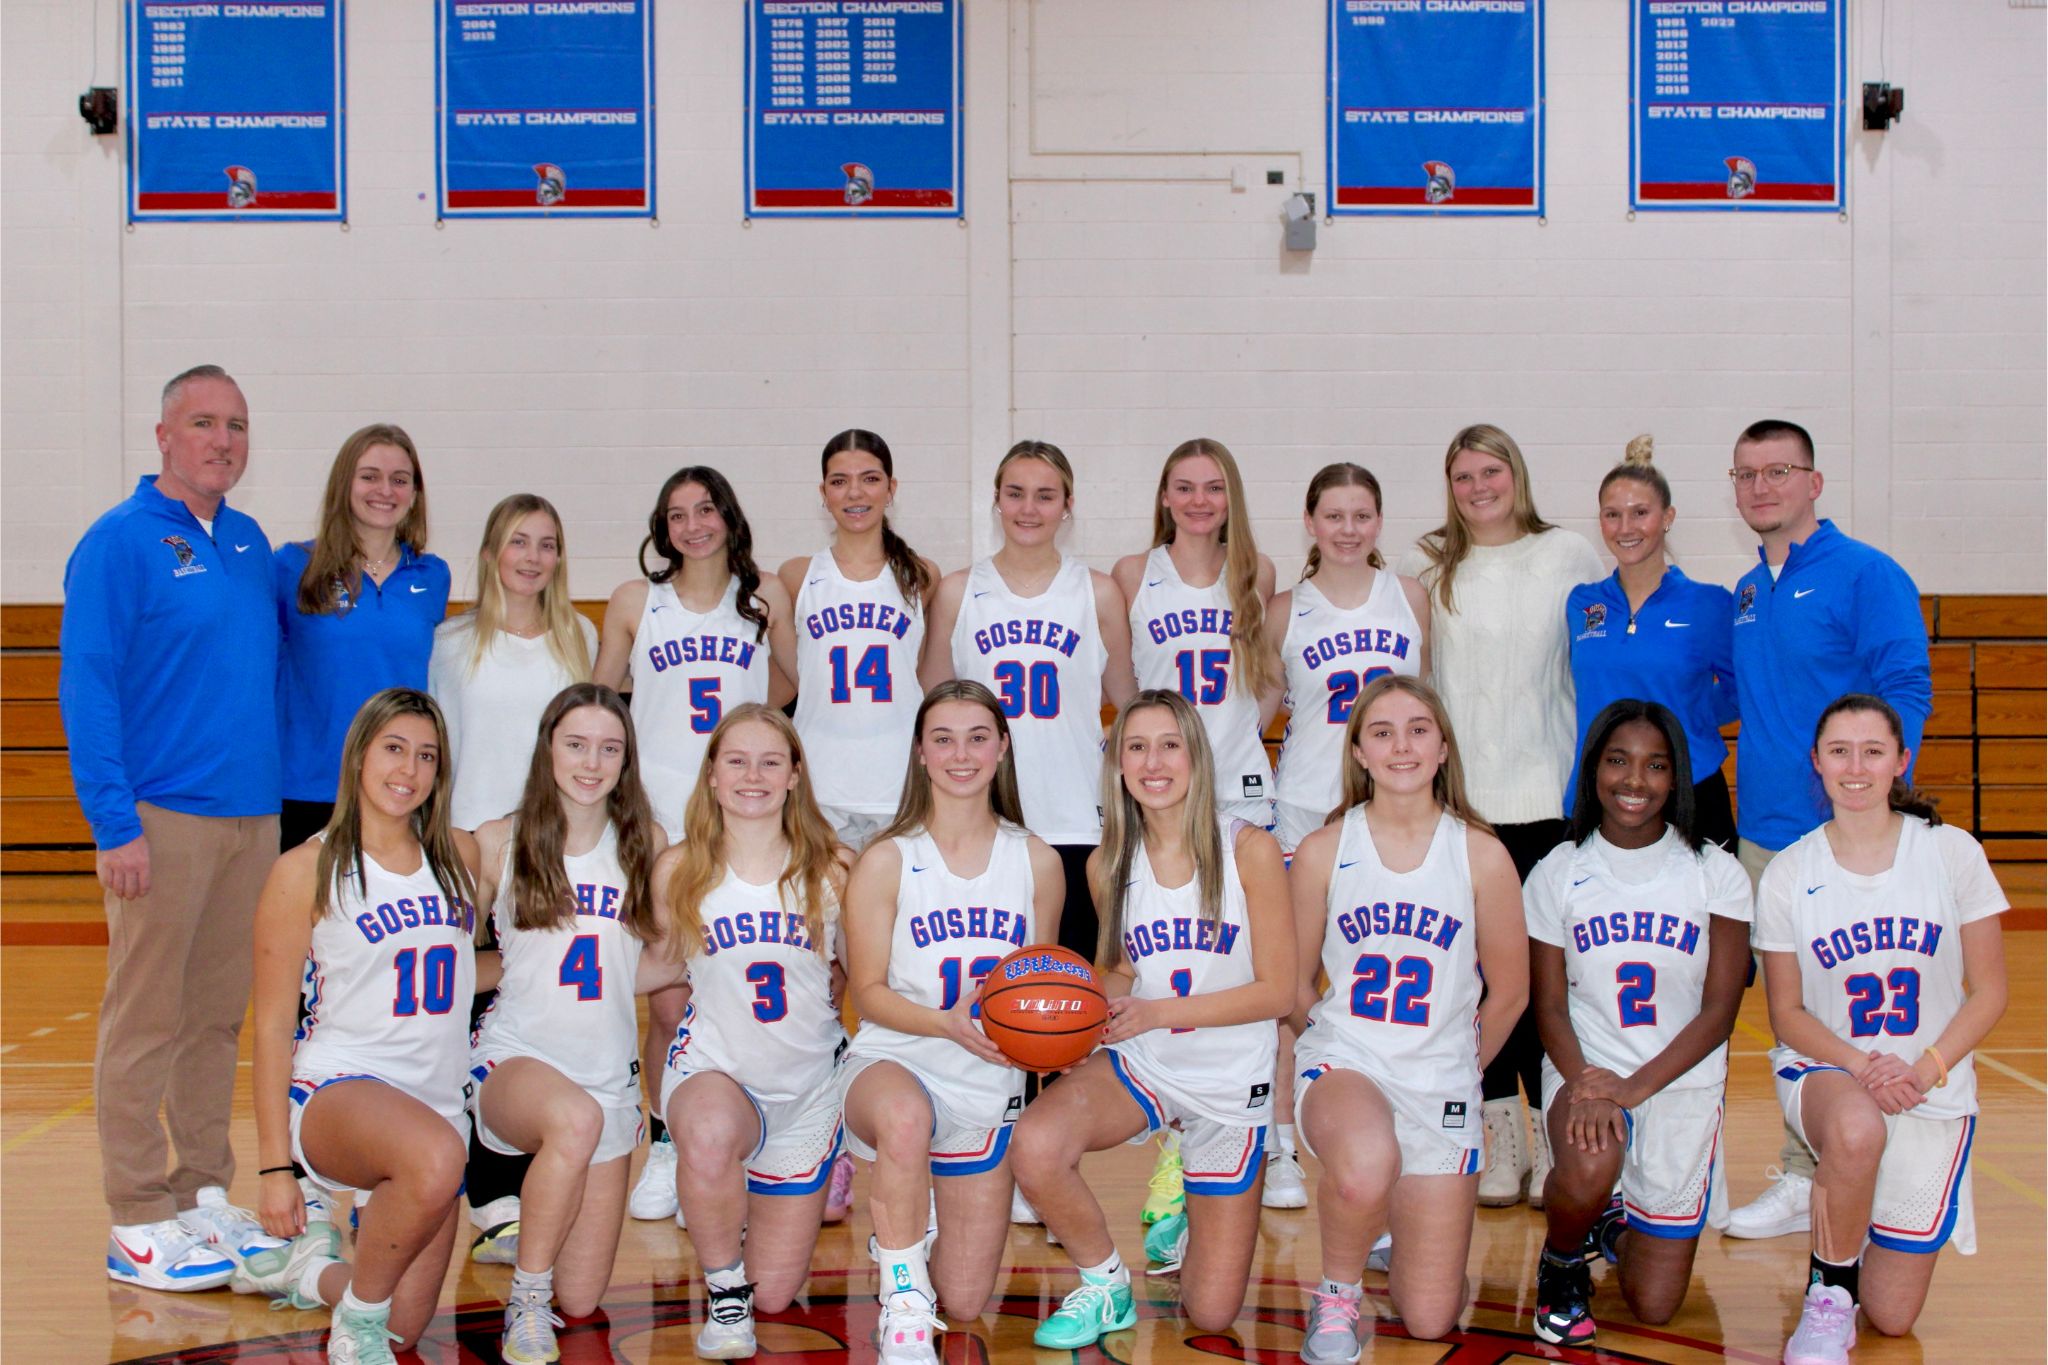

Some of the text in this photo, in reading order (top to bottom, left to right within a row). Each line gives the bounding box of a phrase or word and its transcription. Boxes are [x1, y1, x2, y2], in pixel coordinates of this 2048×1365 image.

[146, 5, 325, 17] SECTION CHAMPIONS
[455, 2, 635, 16] SECTION CHAMPIONS
[763, 1, 943, 14] SECTION CHAMPIONS
[1346, 1, 1525, 12] SECTION CHAMPIONS
[1650, 1, 1827, 13] SECTION CHAMPIONS
[816, 29, 848, 37] 2001
[864, 29, 894, 37] 2011
[1656, 52, 1687, 60] 2014
[147, 116, 327, 128] STATE CHAMPIONS
[456, 112, 637, 125] STATE CHAMPIONS
[763, 113, 944, 125] STATE CHAMPIONS
[1345, 111, 1525, 123] STATE CHAMPIONS
[1649, 106, 1825, 119] STATE CHAMPIONS
[807, 603, 912, 640] GOSHEN
[974, 619, 1081, 658] GOSHEN
[1148, 608, 1233, 645] GOSHE
[649, 635, 755, 672] GOSHEN
[1302, 629, 1410, 670] GOSHEN
[829, 644, 892, 703] 14
[994, 660, 1060, 719] 30
[1176, 649, 1231, 706] 15
[688, 677, 721, 734] 5
[1326, 666, 1395, 724] 2
[1248, 776, 1257, 785] M
[1124, 918, 1240, 963] GOSHEN
[1337, 902, 1463, 951] GOSHEN
[1573, 911, 1700, 956] GOSHEN
[1811, 916, 1942, 970] GOSHEN
[393, 944, 457, 1017] 10
[559, 934, 602, 1001] 4
[1005, 954, 1092, 983] Wilson
[745, 961, 788, 1024] 3
[1350, 953, 1434, 1027] 22
[1616, 961, 1657, 1028] 2
[1844, 967, 1920, 1038] 23
[1256, 1086, 1263, 1095] S
[1451, 1104, 1460, 1113] M
